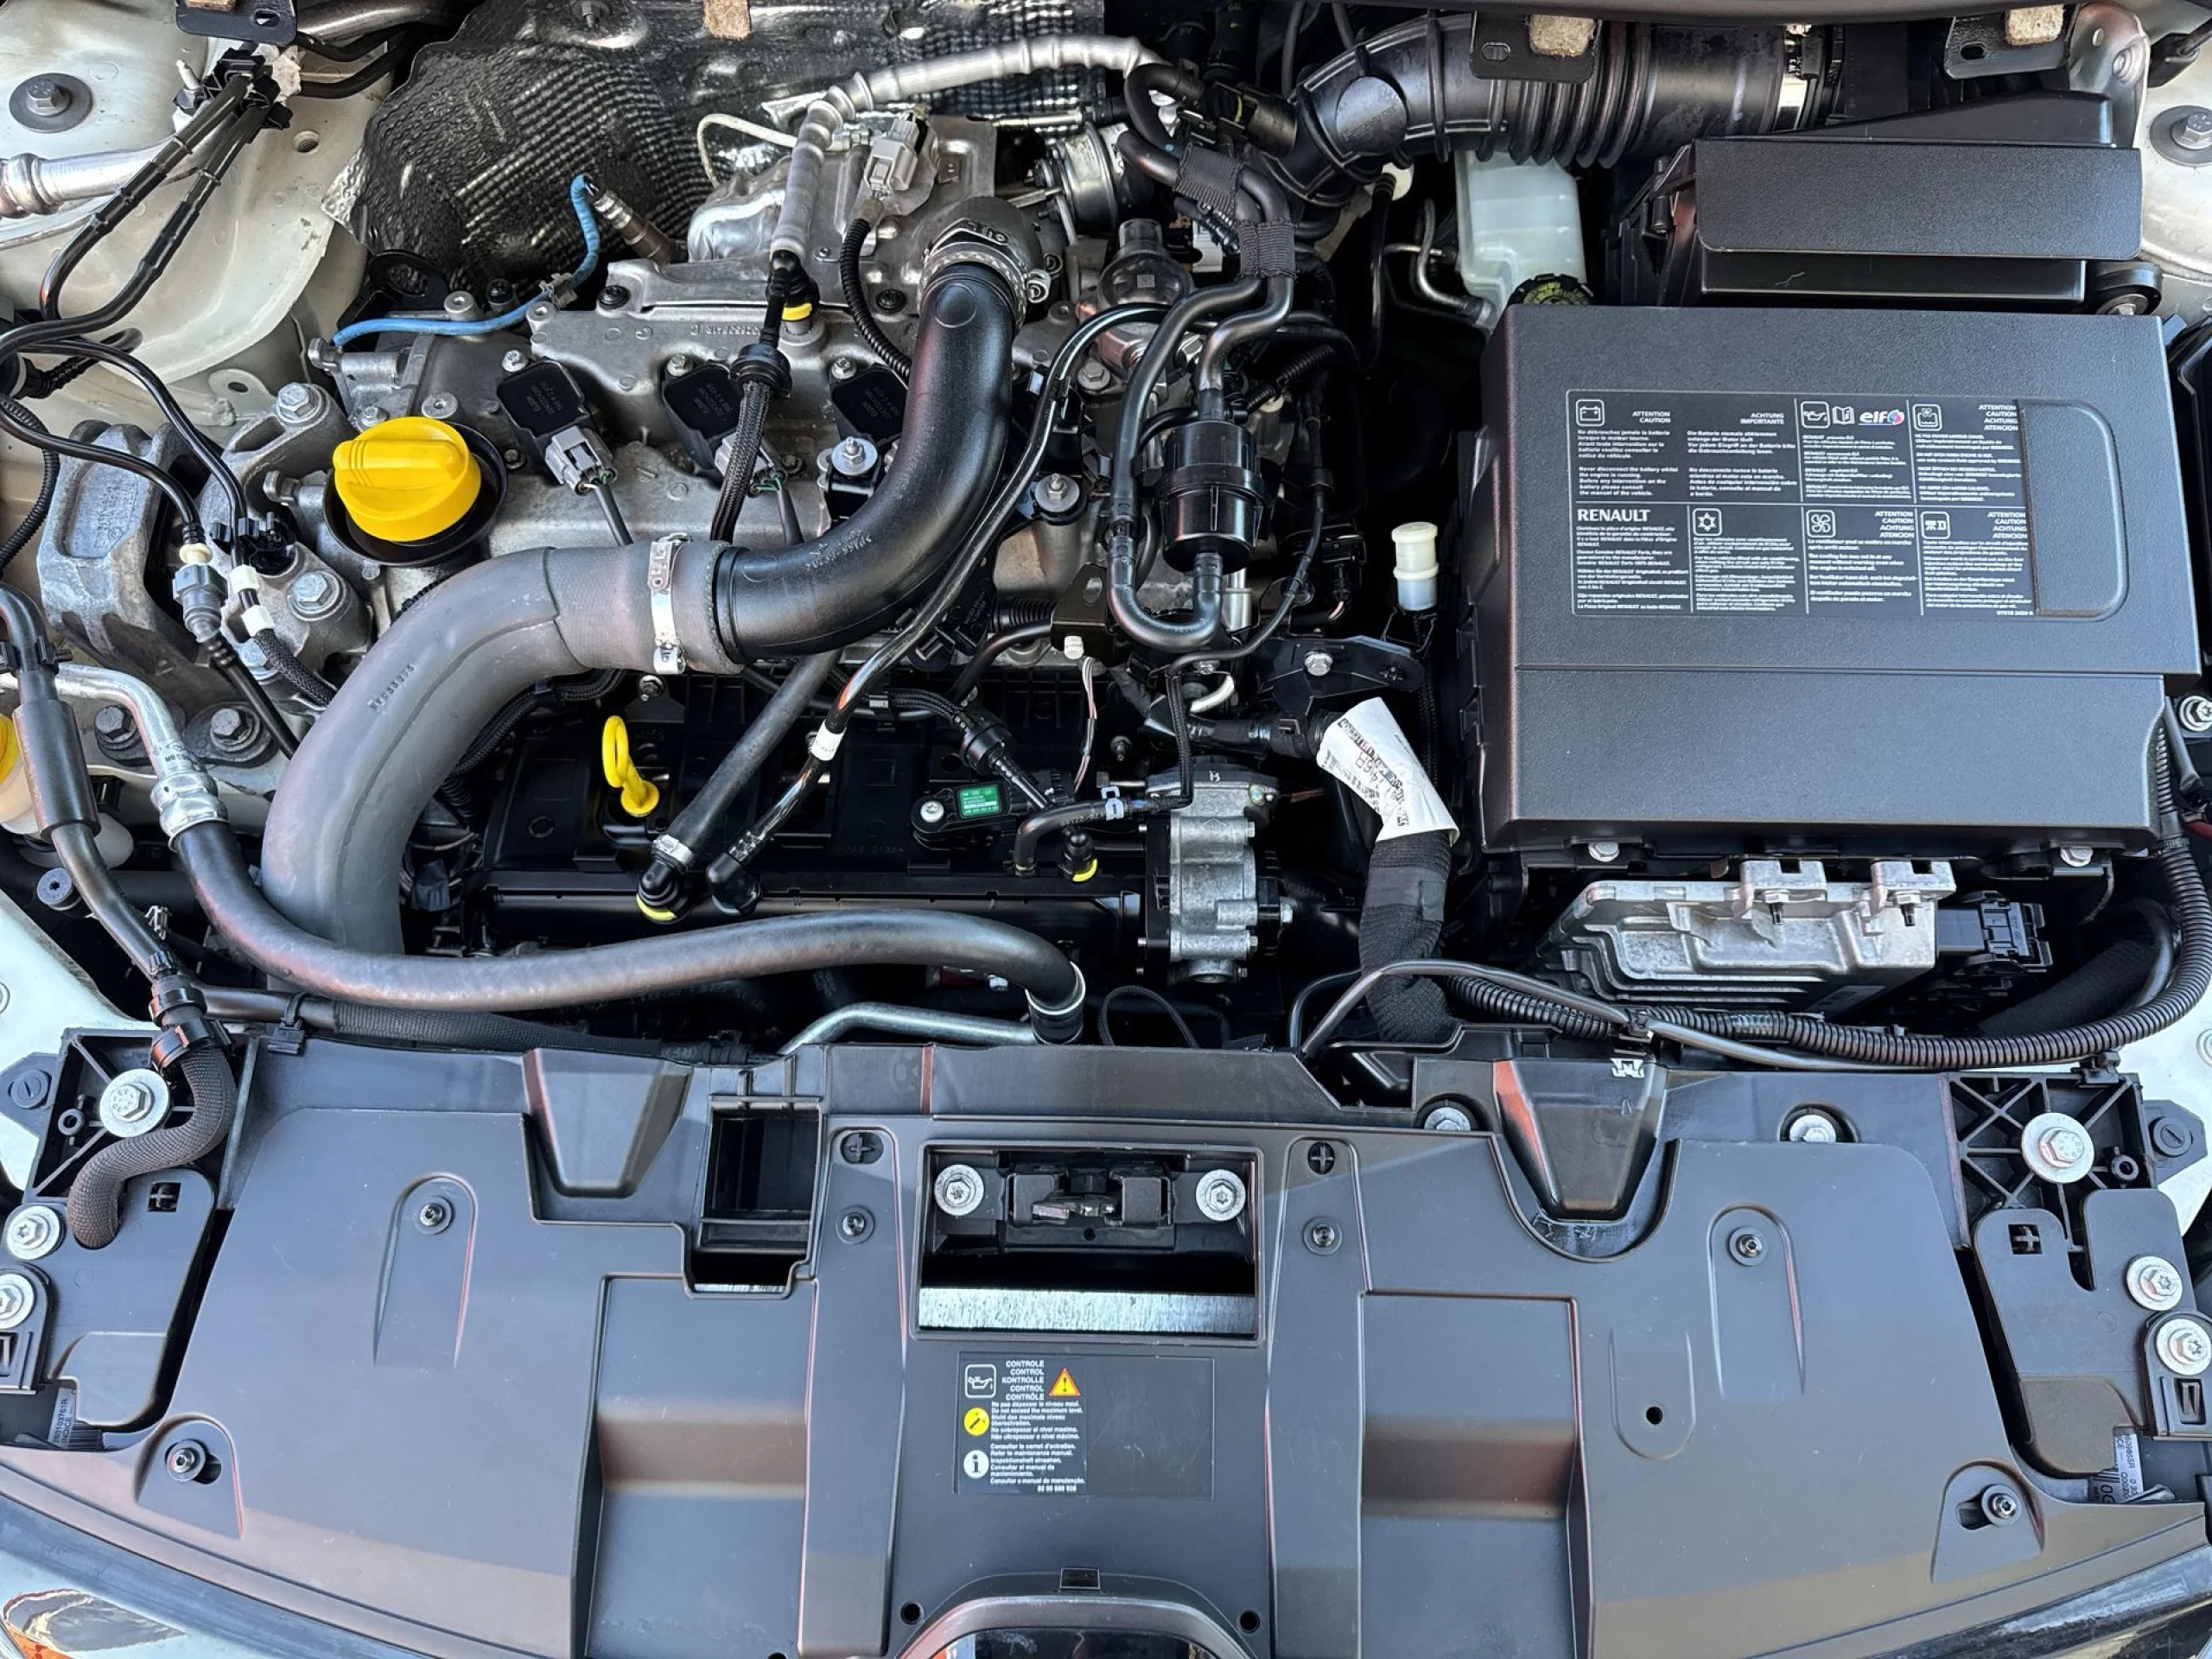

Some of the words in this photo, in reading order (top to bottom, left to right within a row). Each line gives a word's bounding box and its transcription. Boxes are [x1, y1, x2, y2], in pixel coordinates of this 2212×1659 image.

[1859, 410, 1888, 423] elf
[1577, 508, 1650, 522] RENAULT
[1005, 1392, 1045, 1401] CONTRÔLE
